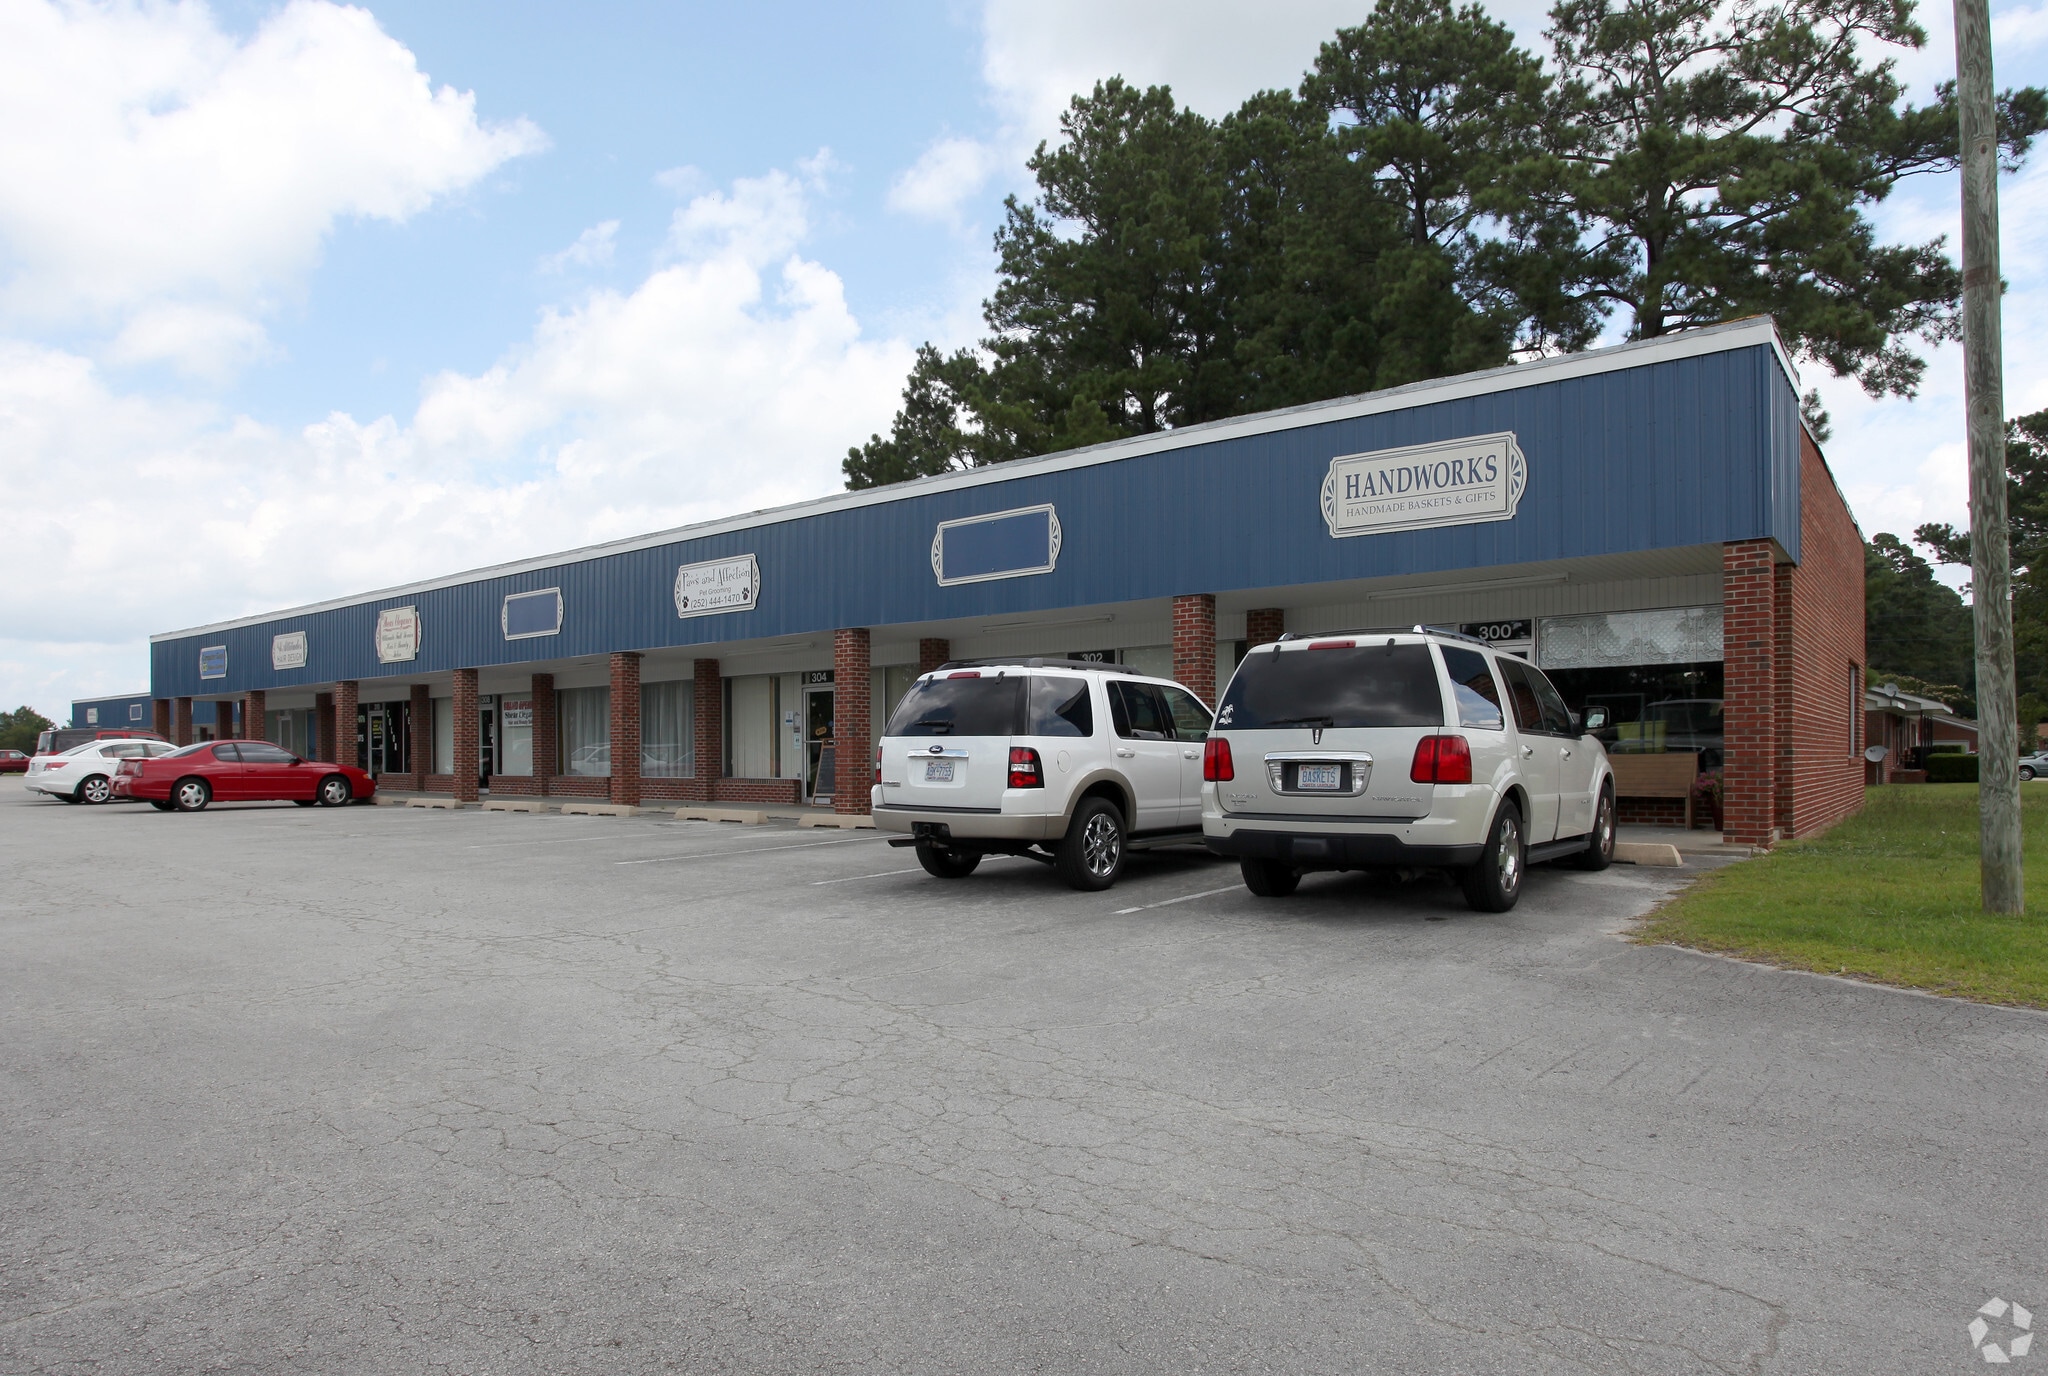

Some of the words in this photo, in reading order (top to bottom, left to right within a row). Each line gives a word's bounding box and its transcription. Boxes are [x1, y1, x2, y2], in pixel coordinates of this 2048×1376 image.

[1345, 454, 1498, 500] HANDWORKS
[1346, 502, 1406, 518] HANDMADE
[1408, 493, 1452, 510] BASKETS
[1454, 494, 1462, 504] &
[1465, 491, 1496, 503] GIFTS
[682, 572, 700, 592] Paws
[701, 568, 715, 585] and
[717, 566, 751, 587] Affection
[708, 586, 732, 596] Grooming
[690, 599, 708, 609] (252)
[709, 593, 741, 606] 444-1470
[1479, 624, 1512, 640] 300
[1082, 652, 1103, 664] 302
[811, 672, 827, 683] 304
[1302, 770, 1336, 784] BASKETS
